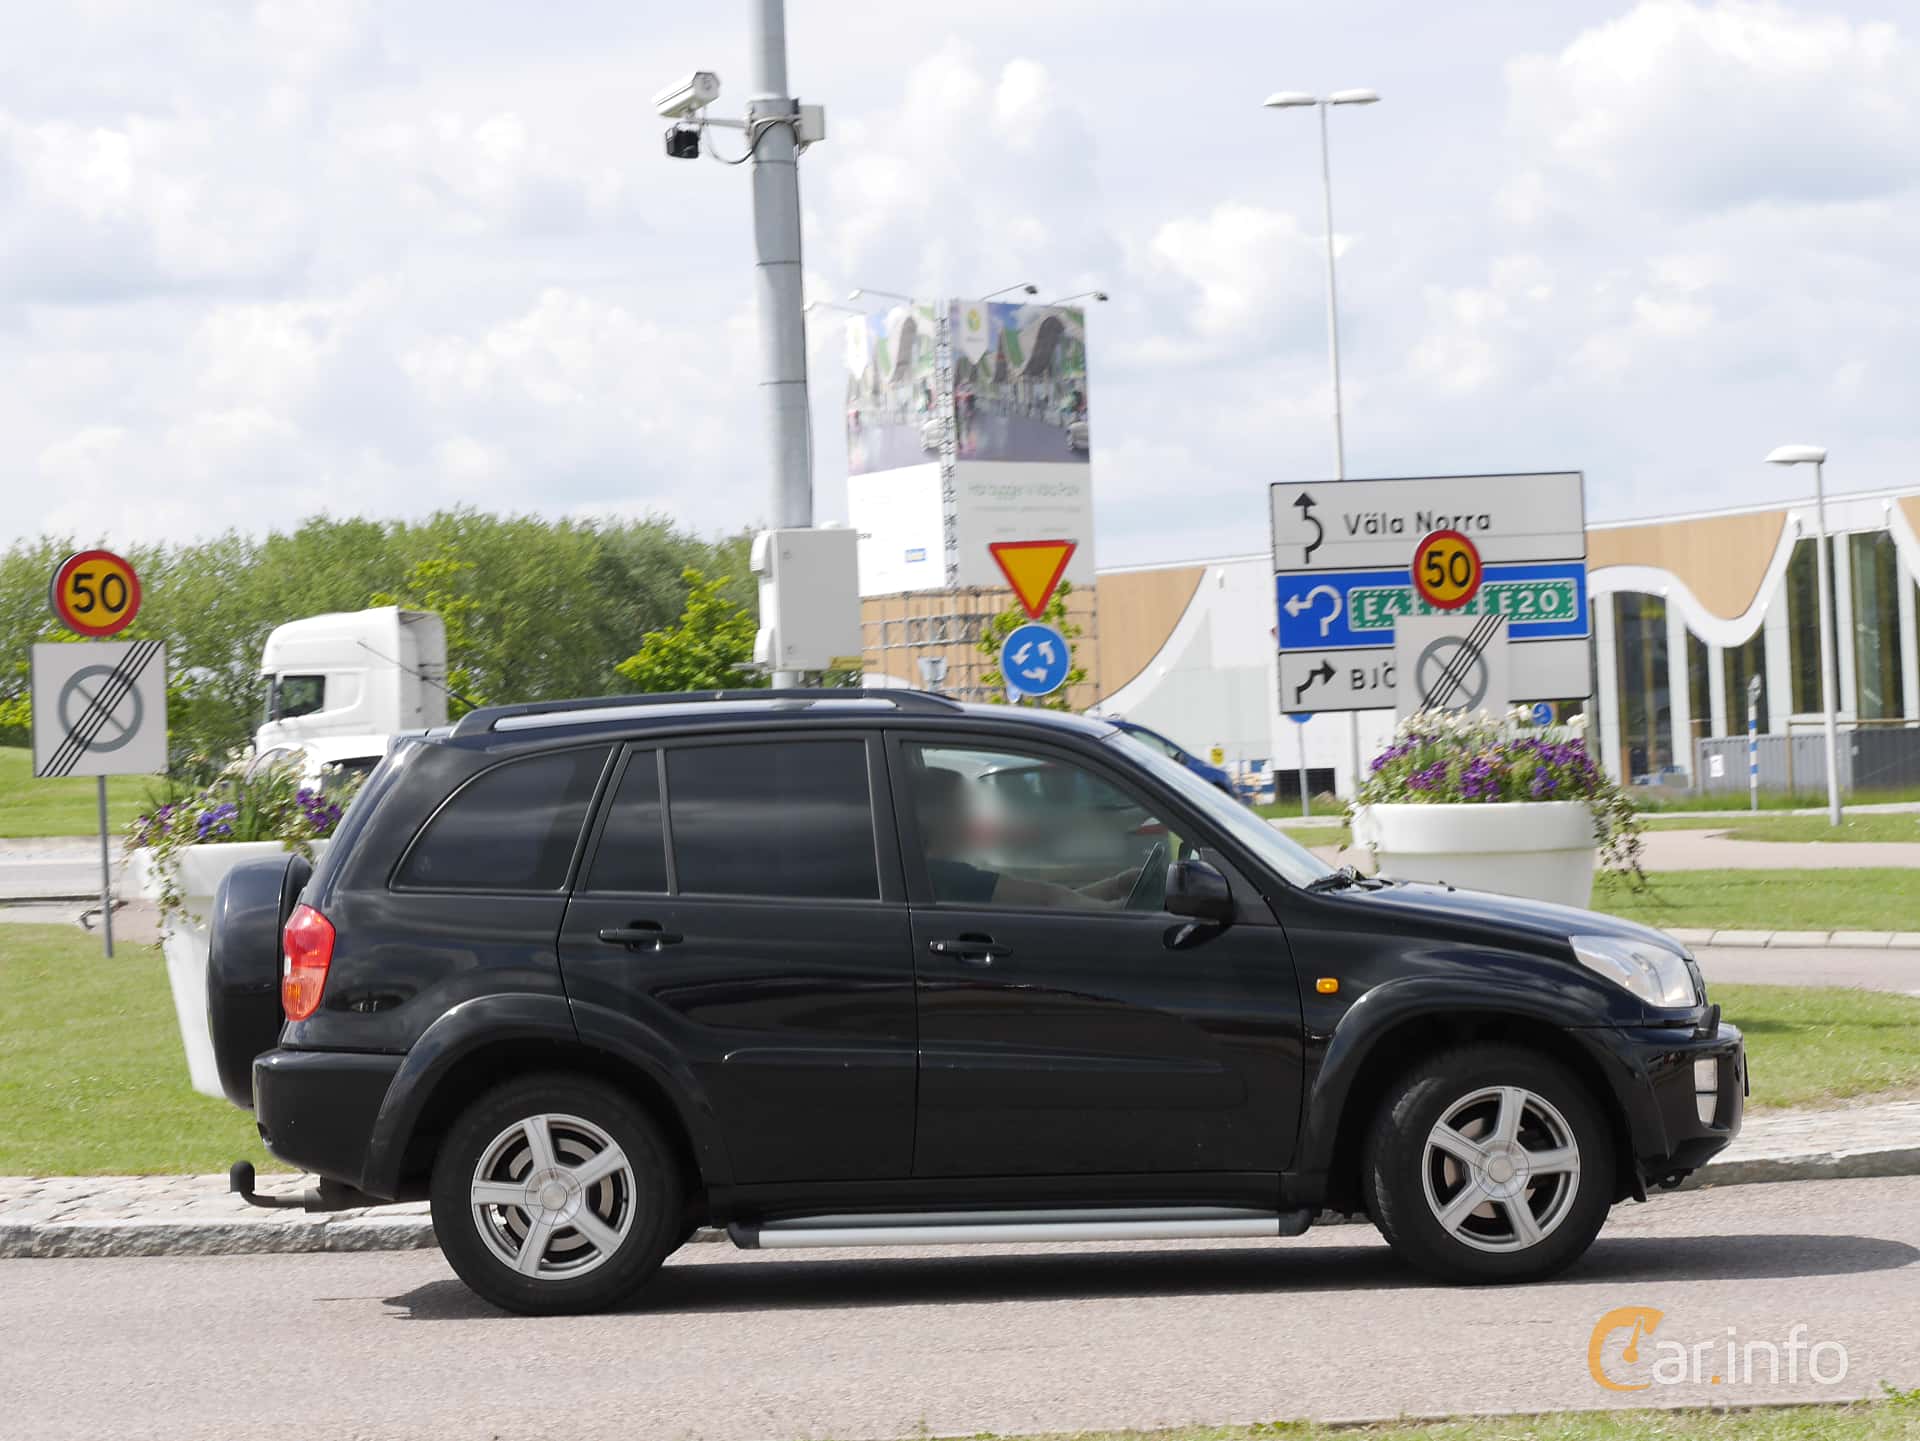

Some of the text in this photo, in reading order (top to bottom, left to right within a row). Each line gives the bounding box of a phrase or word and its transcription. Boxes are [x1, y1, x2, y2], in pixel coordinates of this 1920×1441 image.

[1343, 510, 1491, 536] Väla Norra
[1426, 550, 1471, 587] 50
[72, 573, 127, 613] 50
[1499, 589, 1560, 614] E20
[1364, 596, 1400, 621] E4
